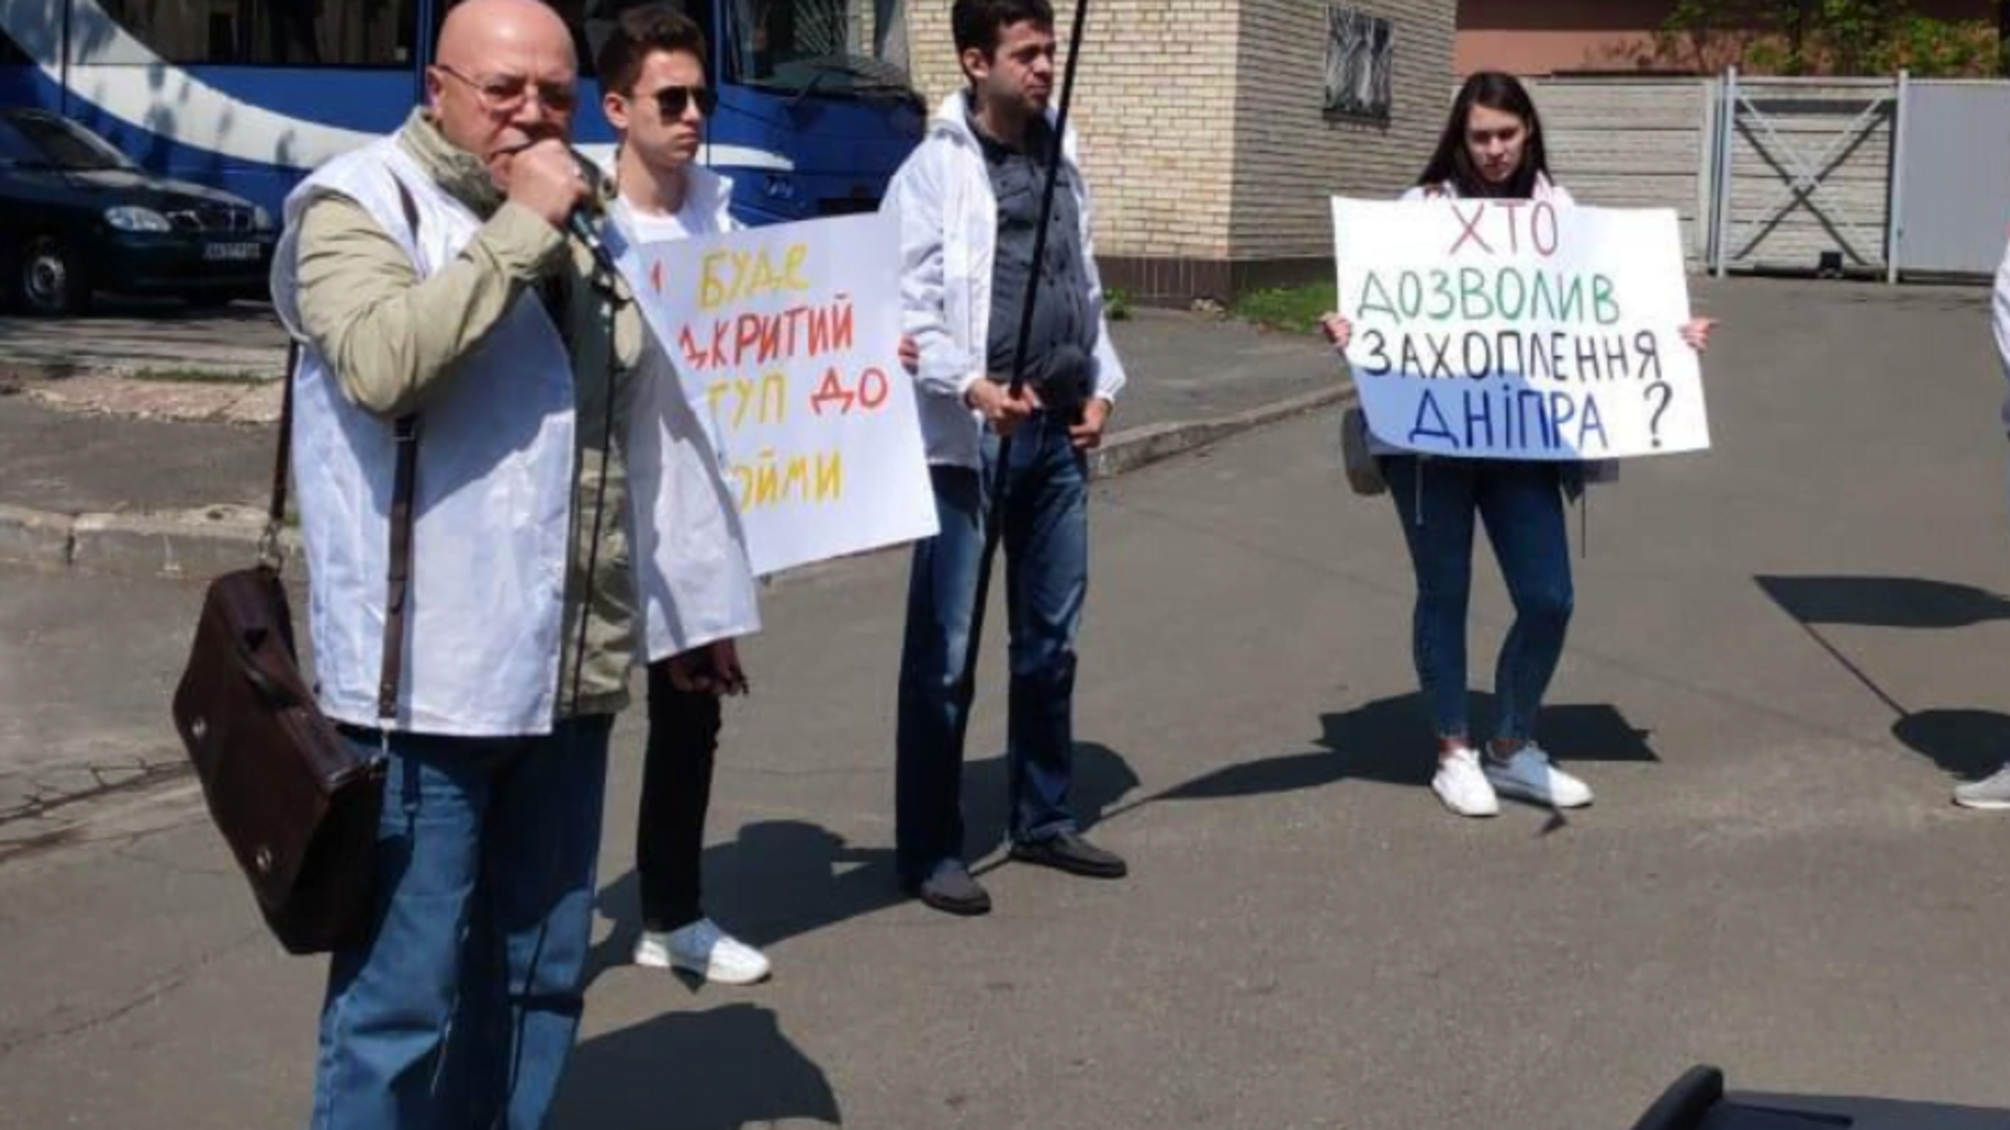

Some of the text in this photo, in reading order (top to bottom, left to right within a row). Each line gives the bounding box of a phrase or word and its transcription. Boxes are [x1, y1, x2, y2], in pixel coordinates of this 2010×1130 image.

[1449, 199, 1557, 255] ХТО
[1357, 267, 1620, 324] ДОЗВОЛИВ
[1358, 329, 1662, 381] ЗАХОПЛЕННЯ
[810, 367, 888, 415] ДО
[1643, 381, 1674, 449] ?
